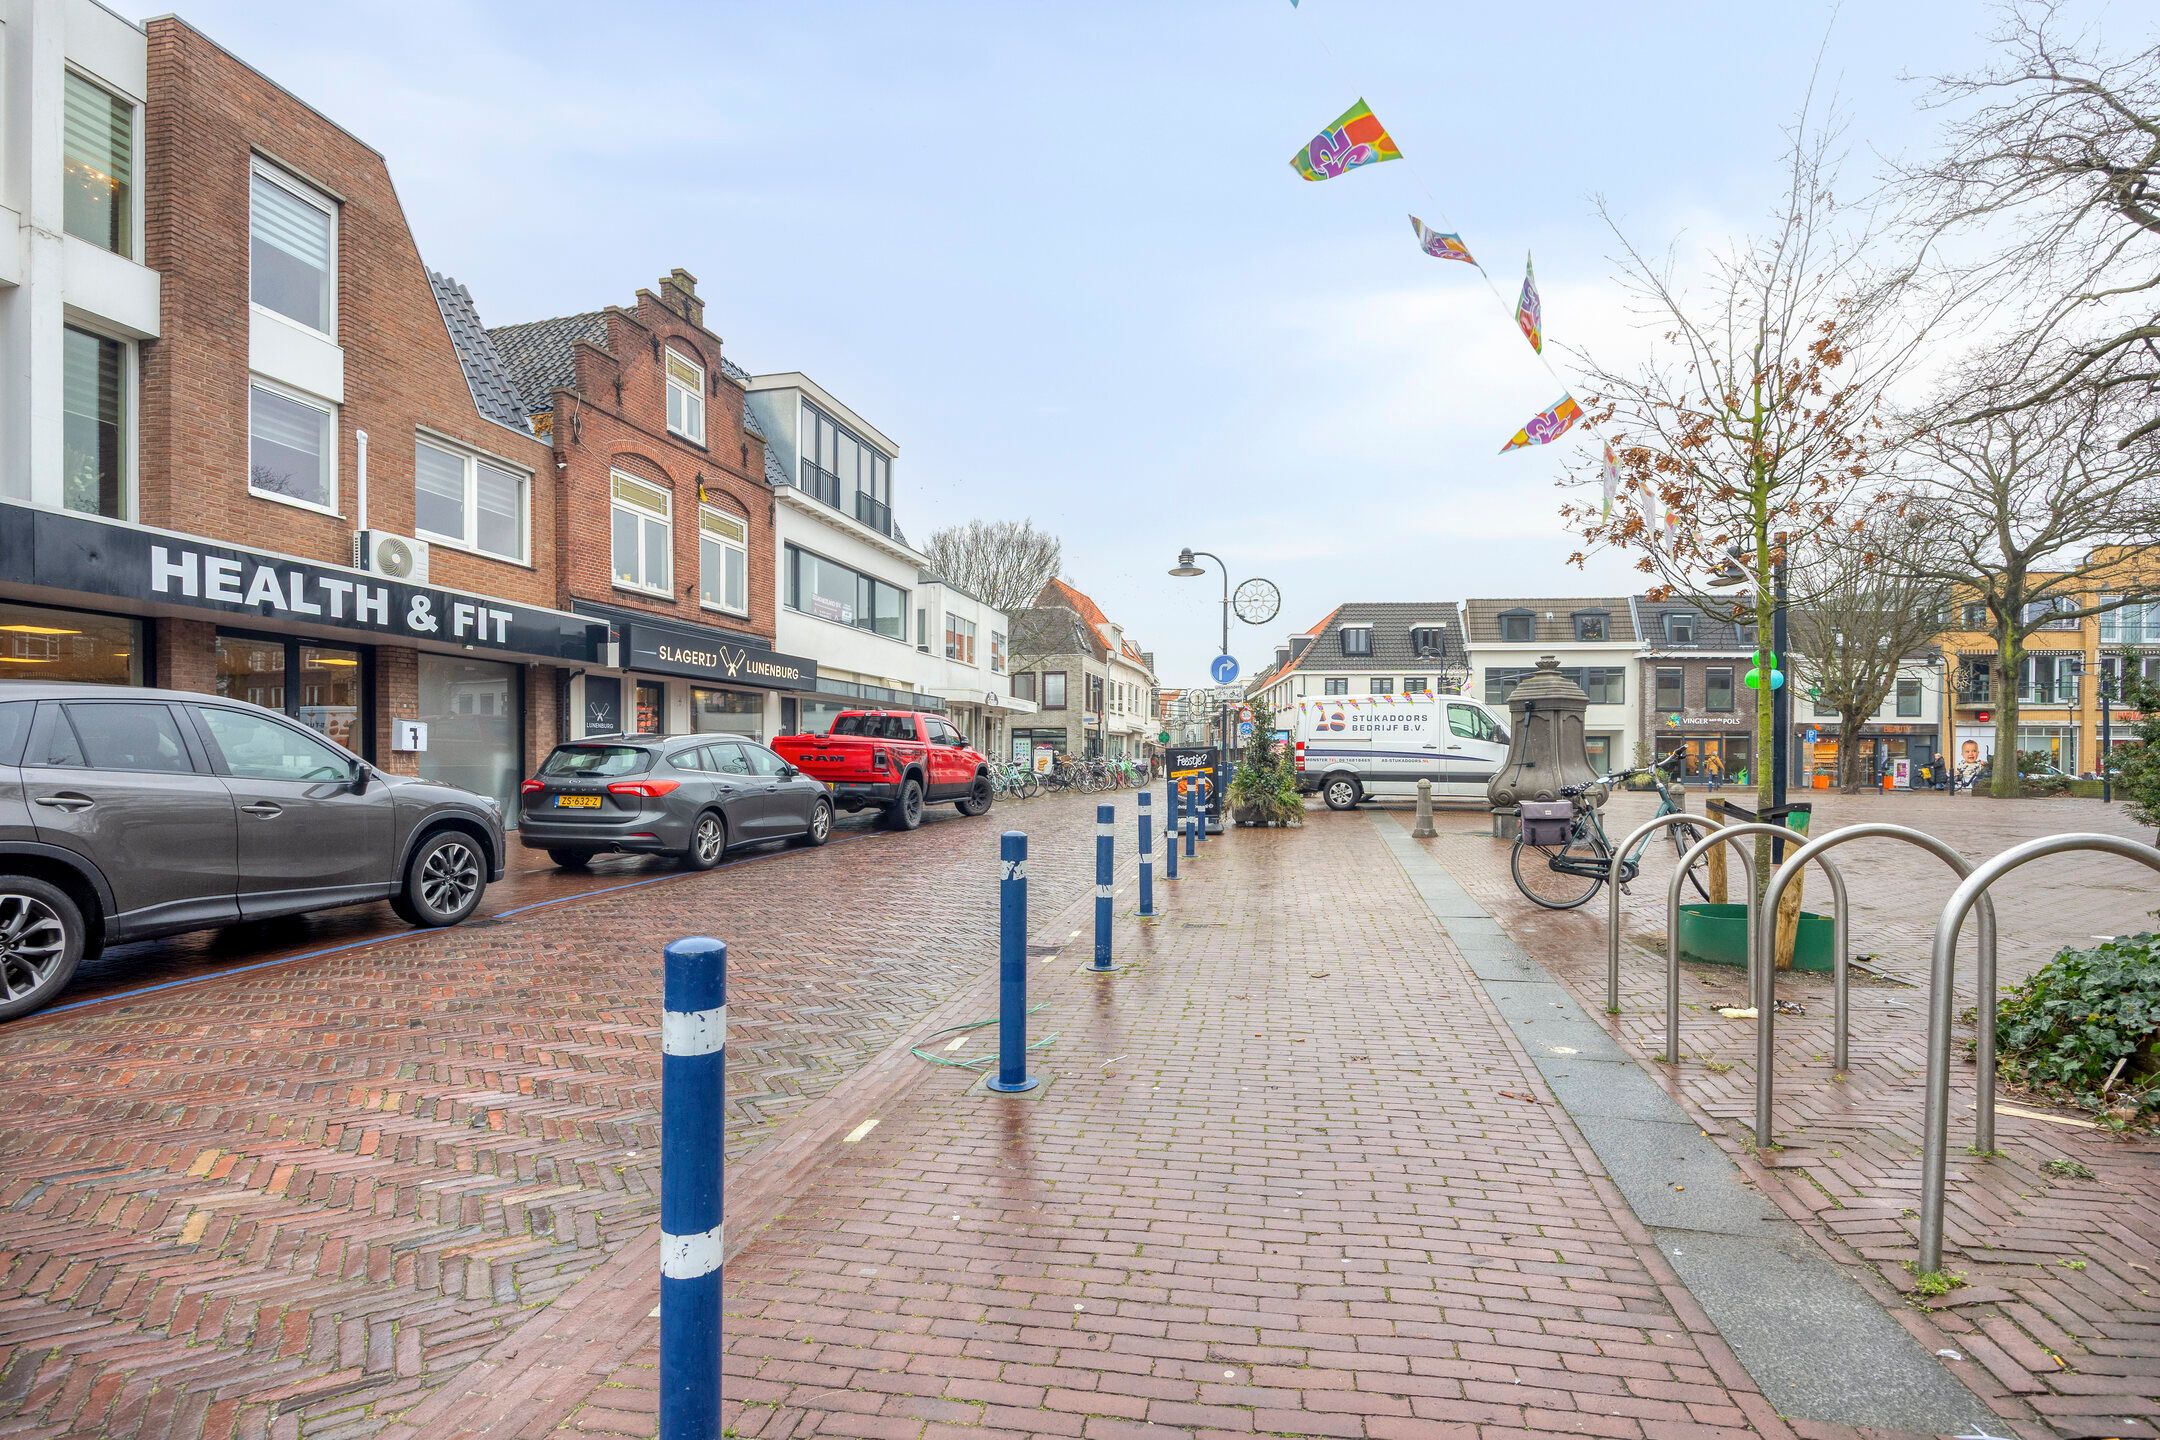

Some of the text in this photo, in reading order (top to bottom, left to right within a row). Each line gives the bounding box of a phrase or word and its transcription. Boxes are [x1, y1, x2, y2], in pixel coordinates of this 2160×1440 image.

[150, 545, 513, 644] HEALTH & FIT
[659, 645, 799, 680] SLAGERIJ LUNENBURG
[1352, 714, 1428, 722] STUKADOORS
[1352, 724, 1425, 732] BEDRIJF B.V.
[1176, 753, 1207, 768] Feestje?
[561, 796, 598, 806] ZS-632-Z
